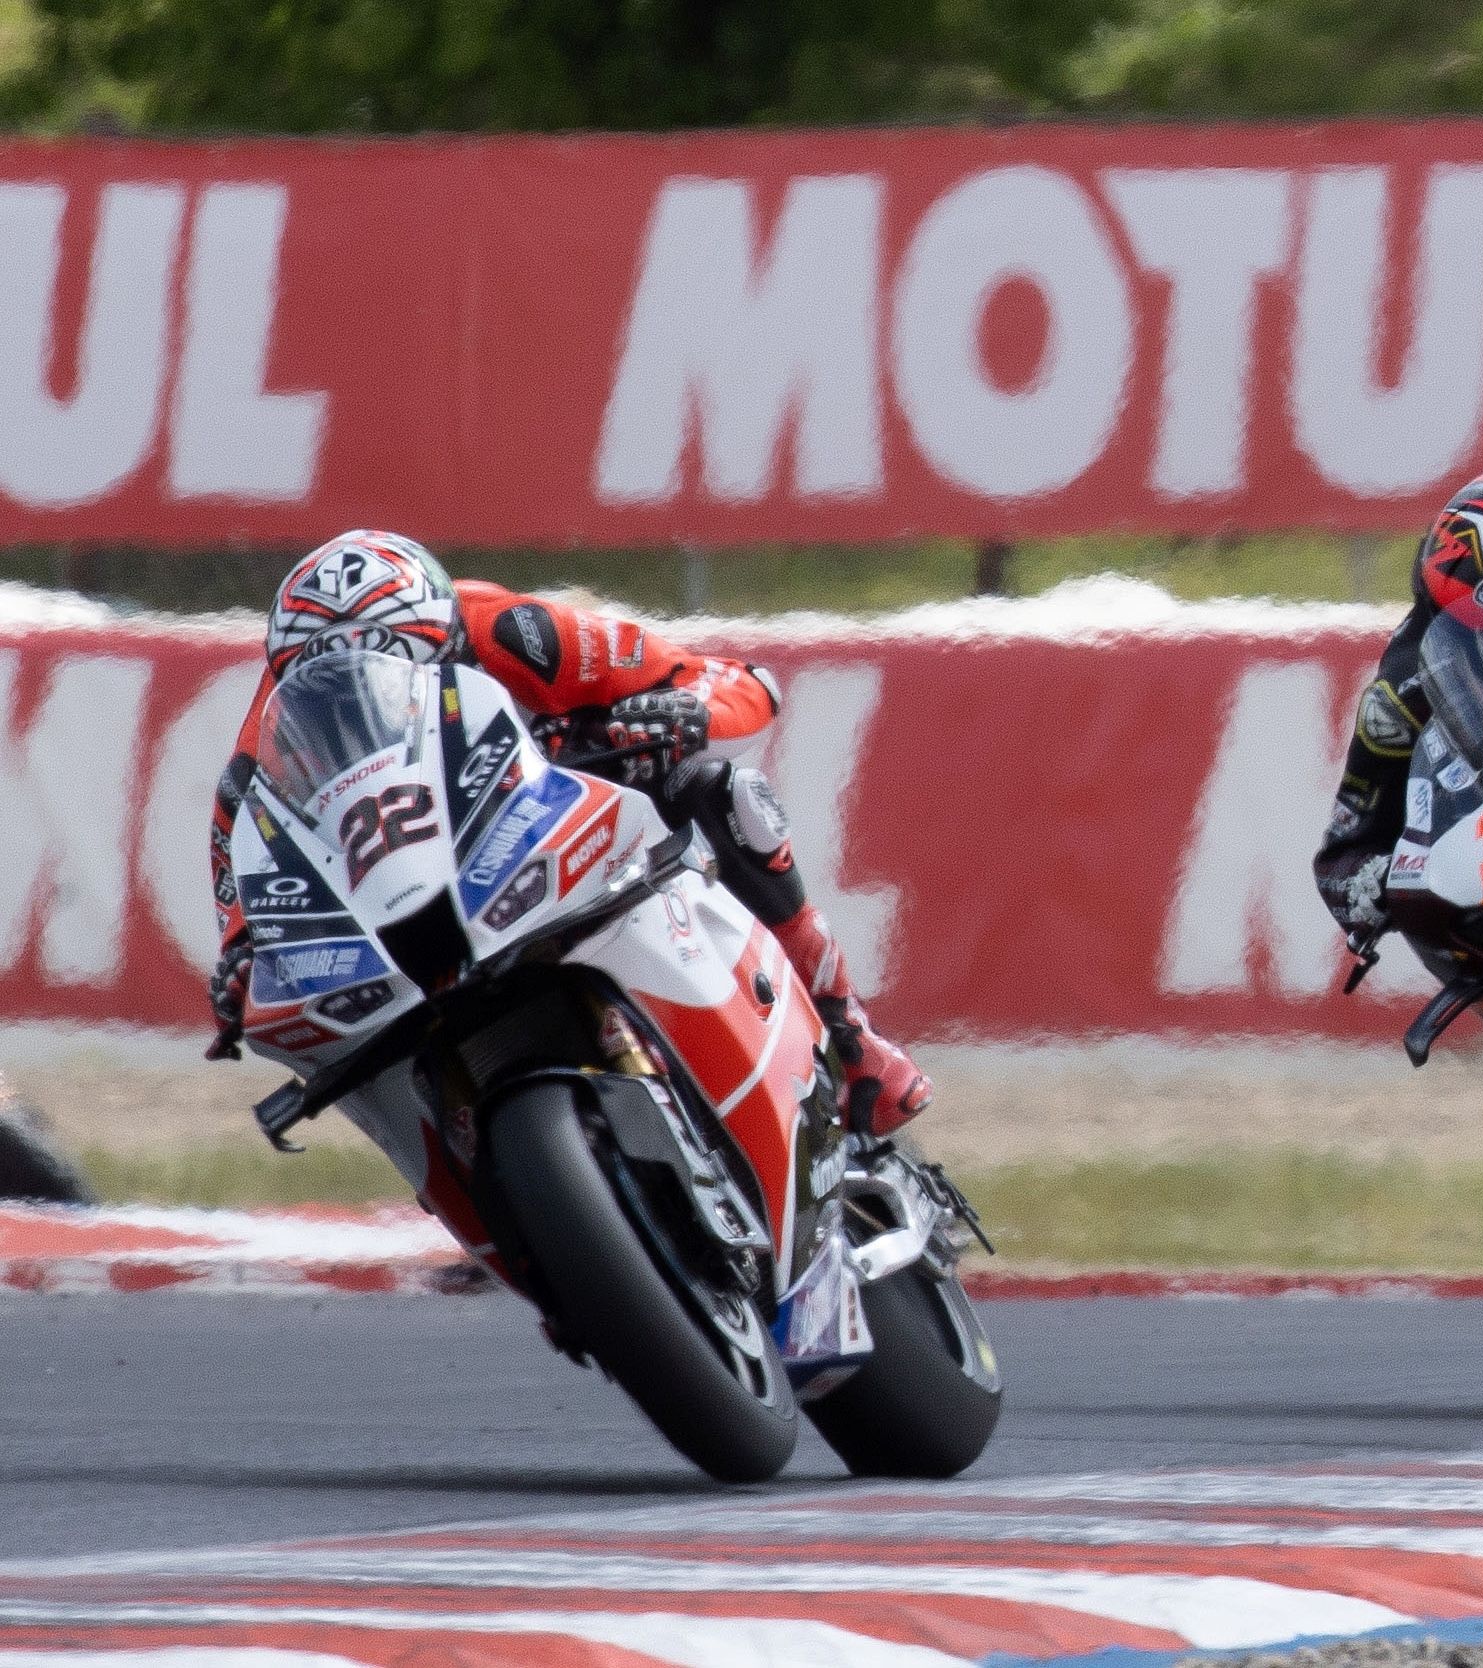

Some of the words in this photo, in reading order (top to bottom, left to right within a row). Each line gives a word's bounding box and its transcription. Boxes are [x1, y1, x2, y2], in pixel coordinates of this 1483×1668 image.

[334, 755, 397, 797] SHOWA
[339, 782, 441, 894] 22
[250, 896, 312, 909] OAKLEY
